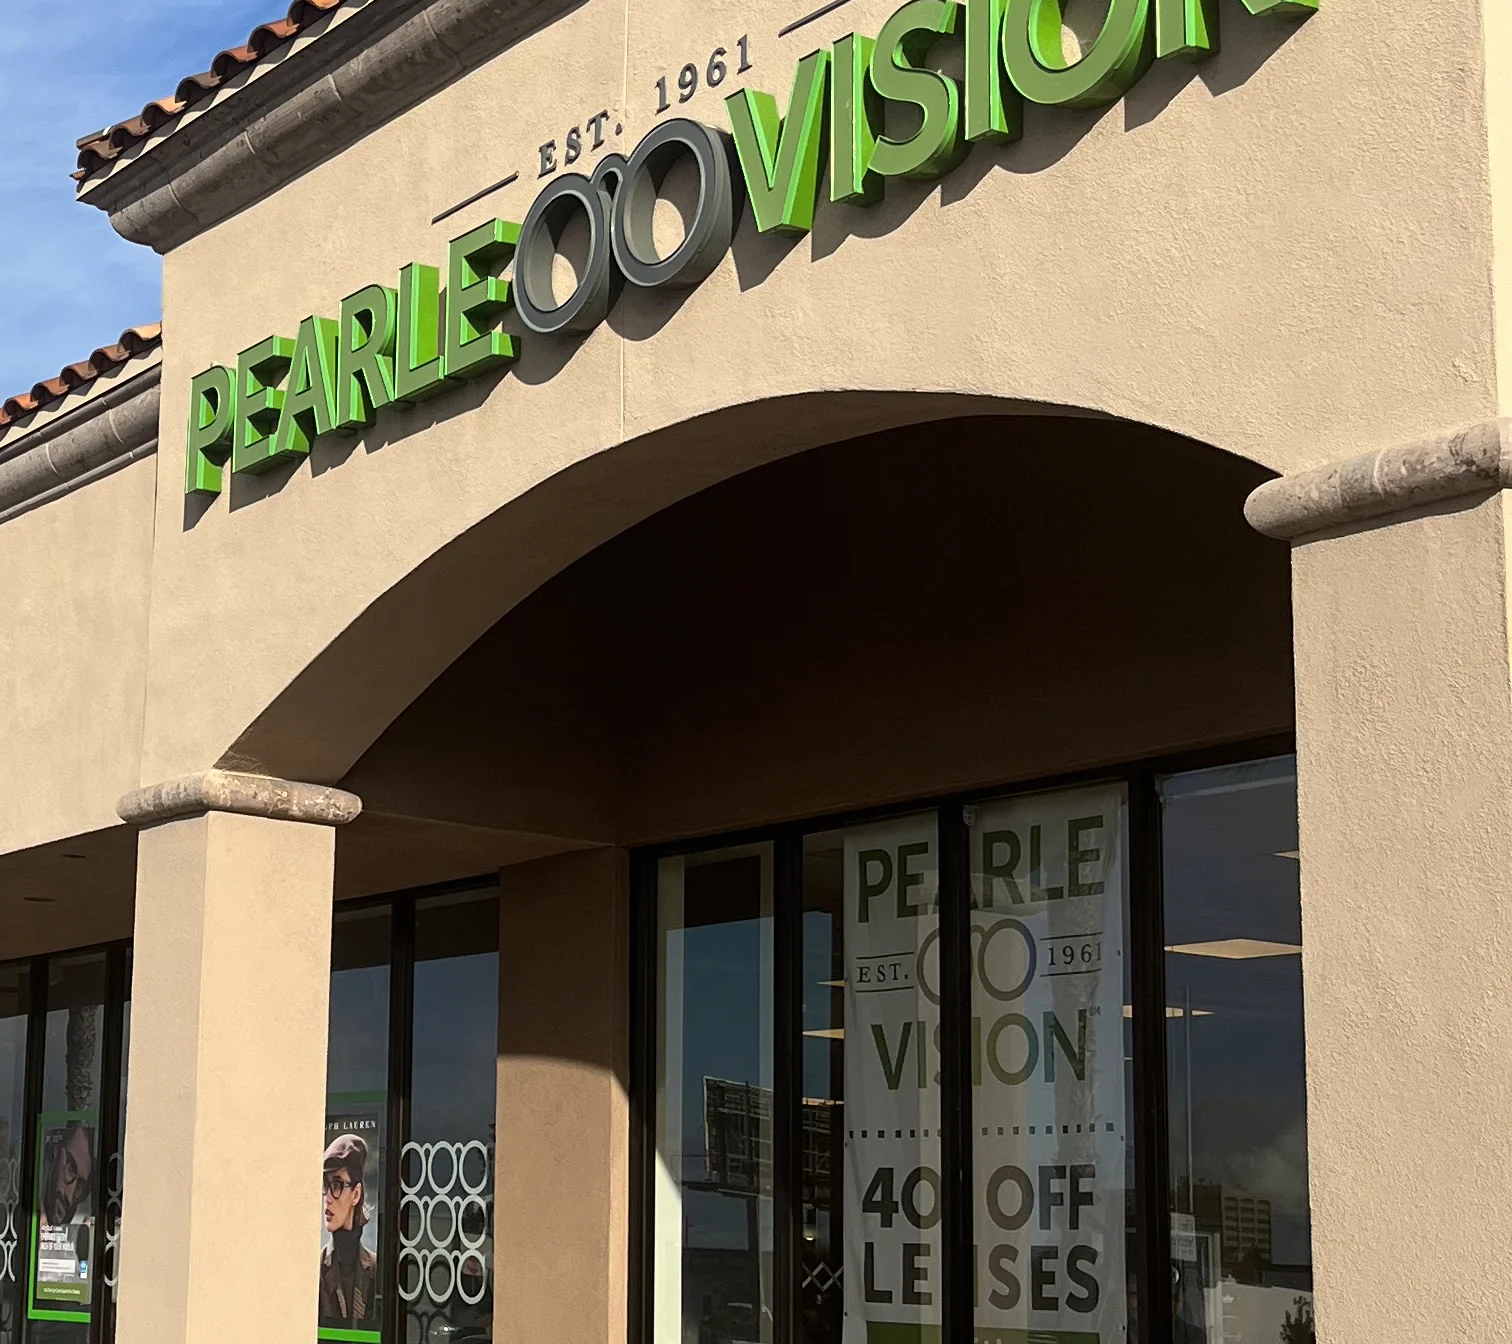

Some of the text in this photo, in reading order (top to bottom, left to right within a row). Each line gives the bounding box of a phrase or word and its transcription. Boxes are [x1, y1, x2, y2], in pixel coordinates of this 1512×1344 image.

[537, 33, 753, 179] EST. 1961
[184, 217, 523, 495] PEARLE
[857, 814, 1105, 924] PERLE
[856, 941, 1103, 984] EST. 1961
[870, 1008, 1088, 1091] VIION
[343, 1120, 376, 1130] LAUREN
[986, 1164, 1096, 1231] OFF
[864, 1241, 1100, 1314] LESES
